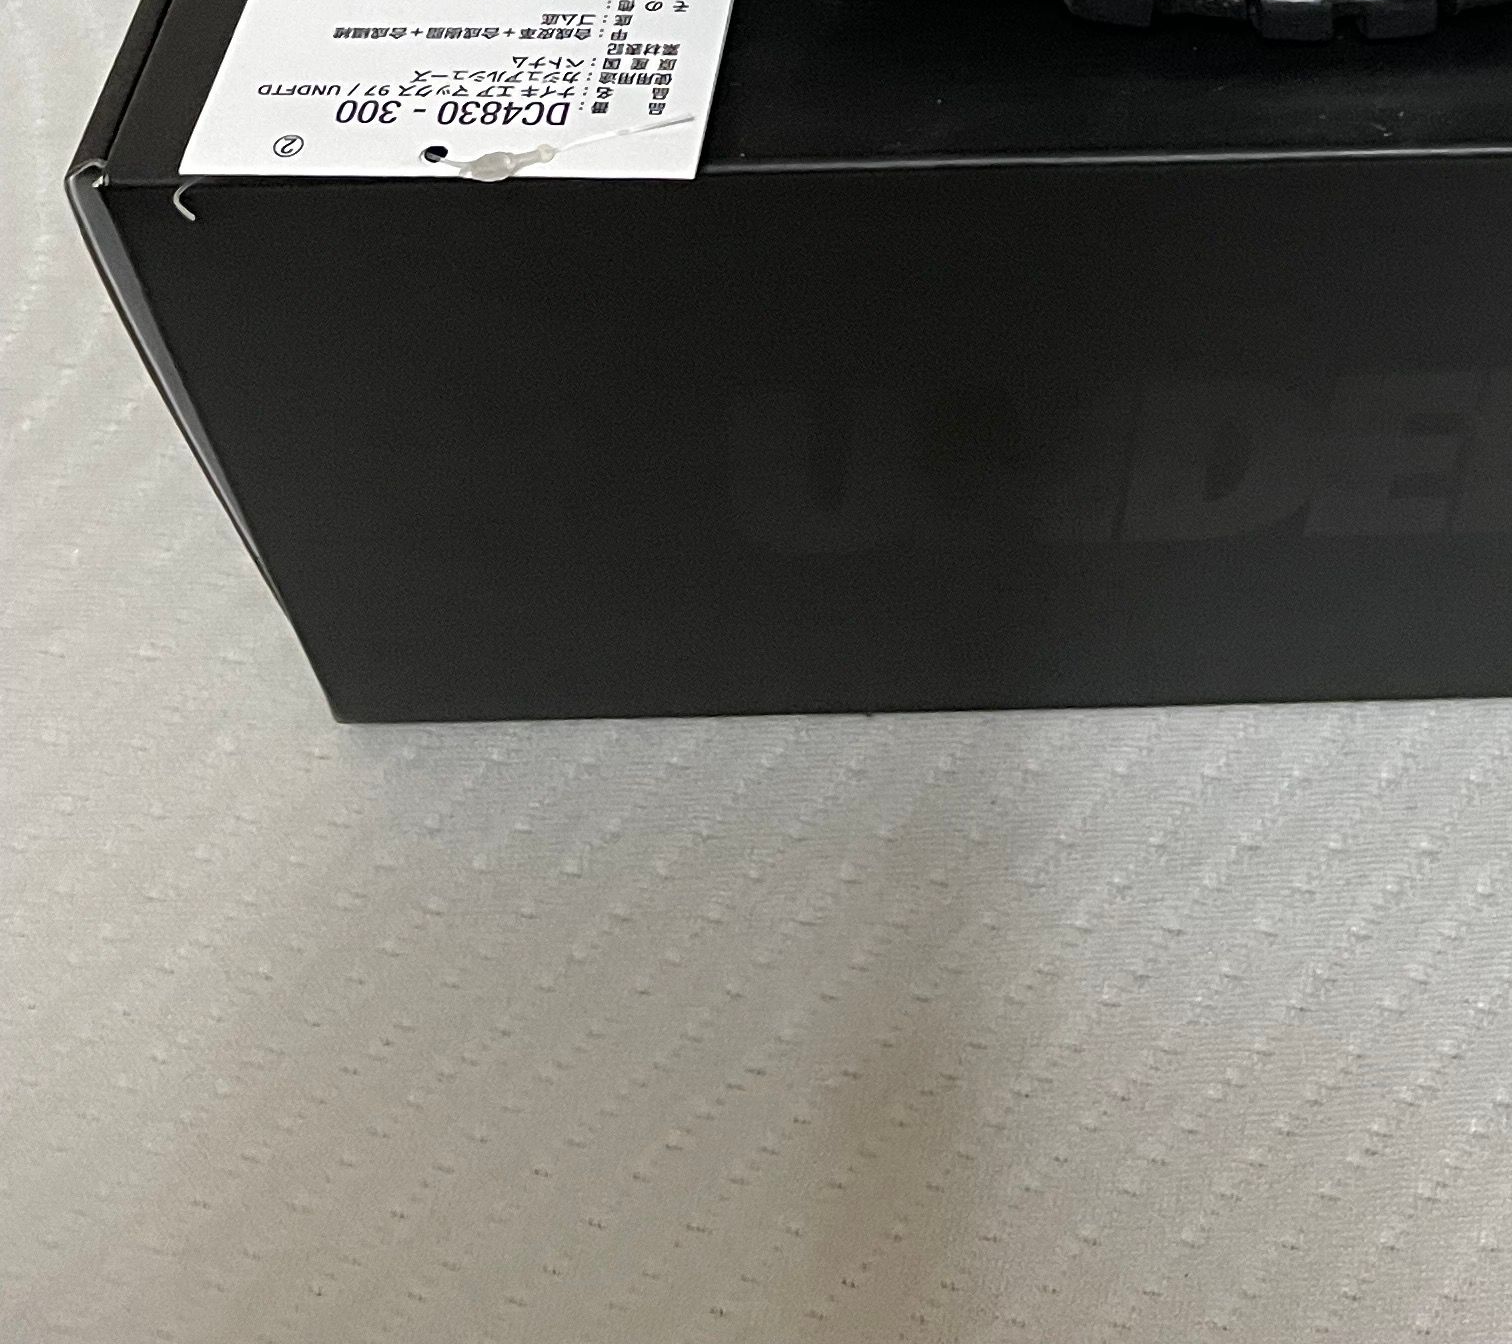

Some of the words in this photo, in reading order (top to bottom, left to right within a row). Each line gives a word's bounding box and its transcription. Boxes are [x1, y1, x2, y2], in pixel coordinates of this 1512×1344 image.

[258, 84, 341, 95] UNDFTD
[364, 85, 390, 96] 97
[399, 86, 470, 97] マックス
[478, 86, 515, 96] エア
[520, 86, 575, 98] ナイキ
[335, 100, 402, 124] 300
[437, 101, 571, 126] DC4830
